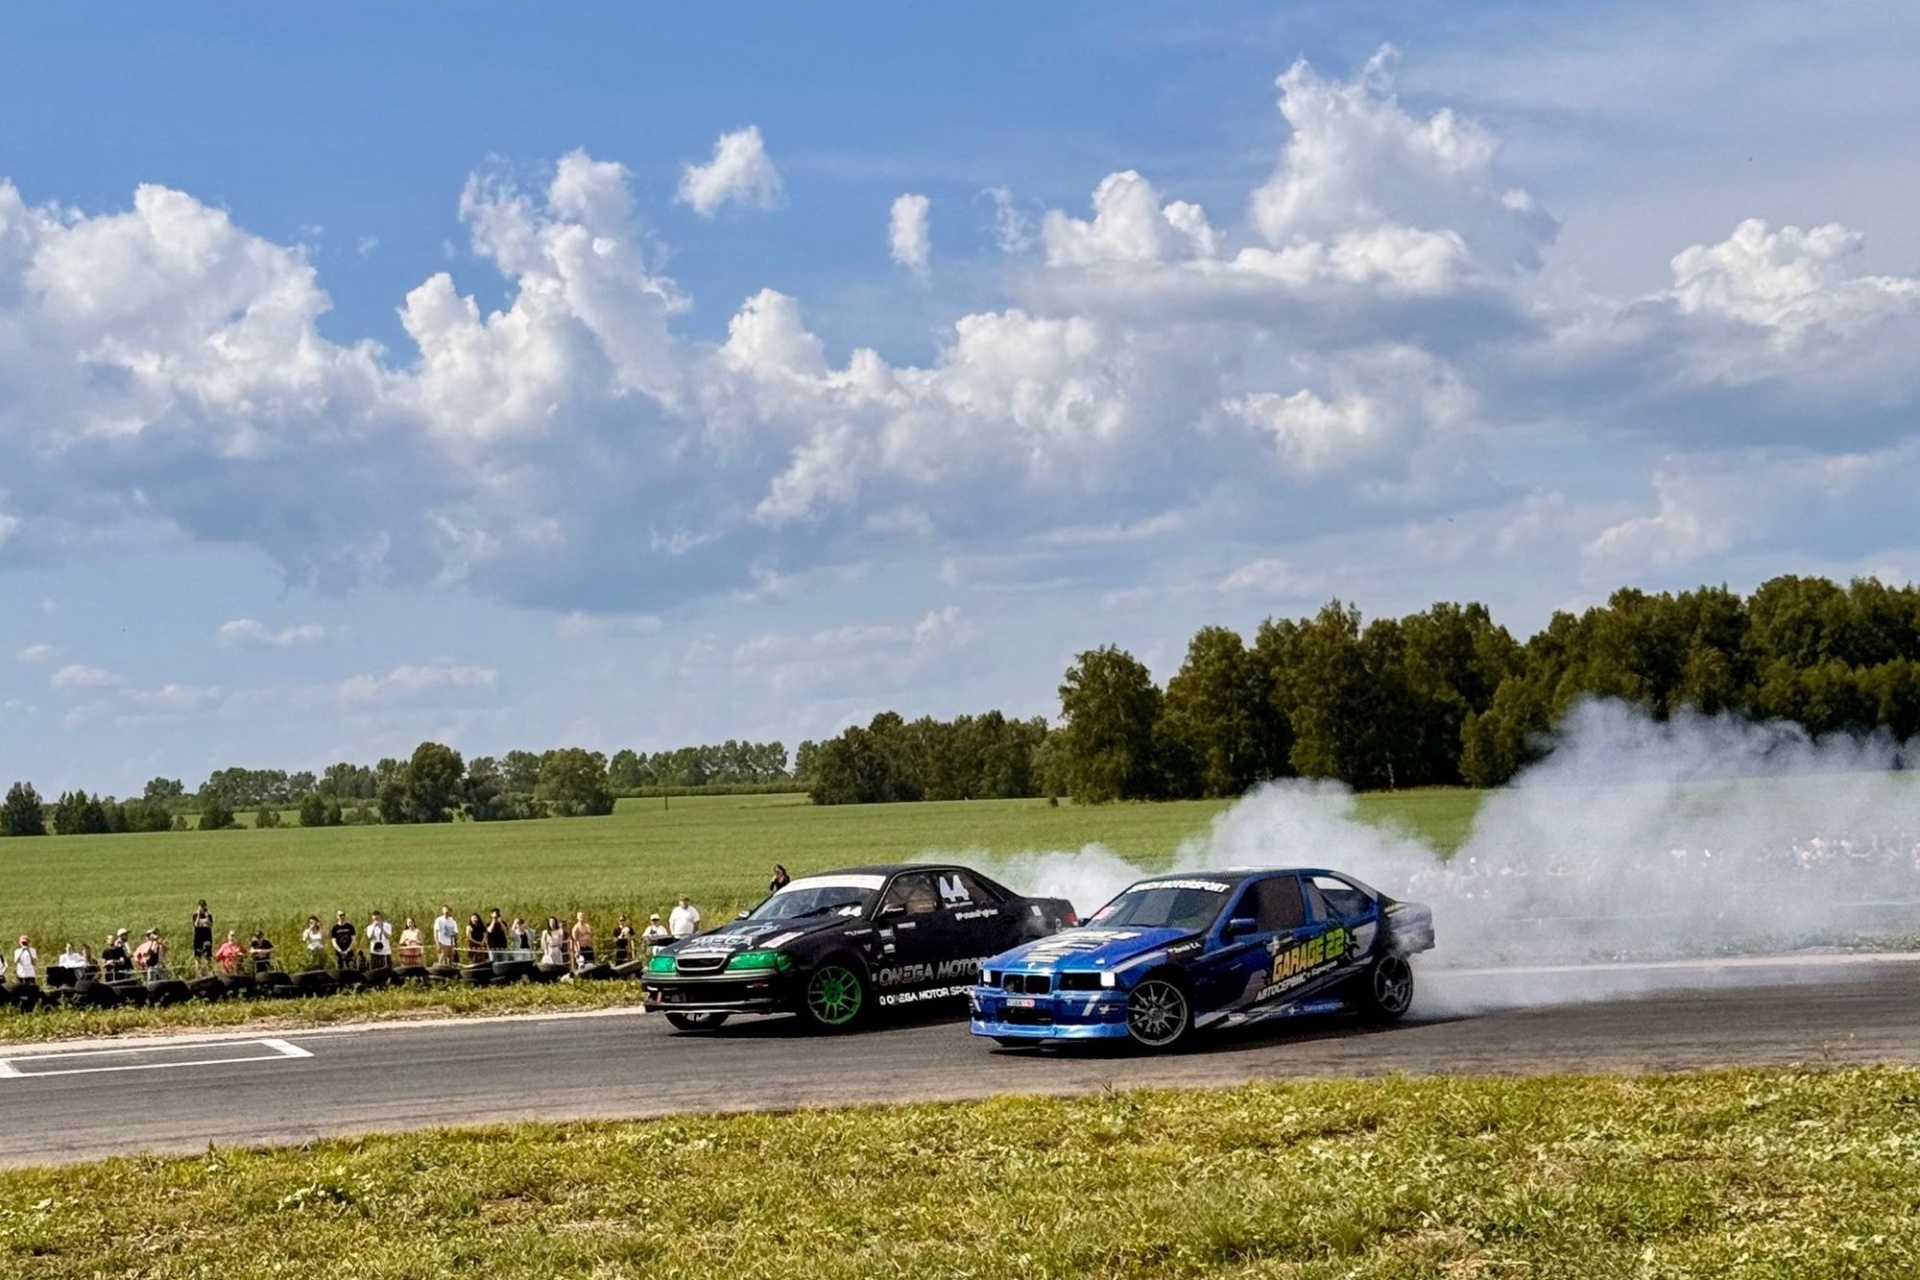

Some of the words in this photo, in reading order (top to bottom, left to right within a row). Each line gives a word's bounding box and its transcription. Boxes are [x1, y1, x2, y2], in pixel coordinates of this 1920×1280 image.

[939, 874, 970, 902] 44
[1272, 936, 1324, 983] GARAGE
[880, 963, 935, 986] OMEGA
[919, 987, 950, 1000] MOTOR
